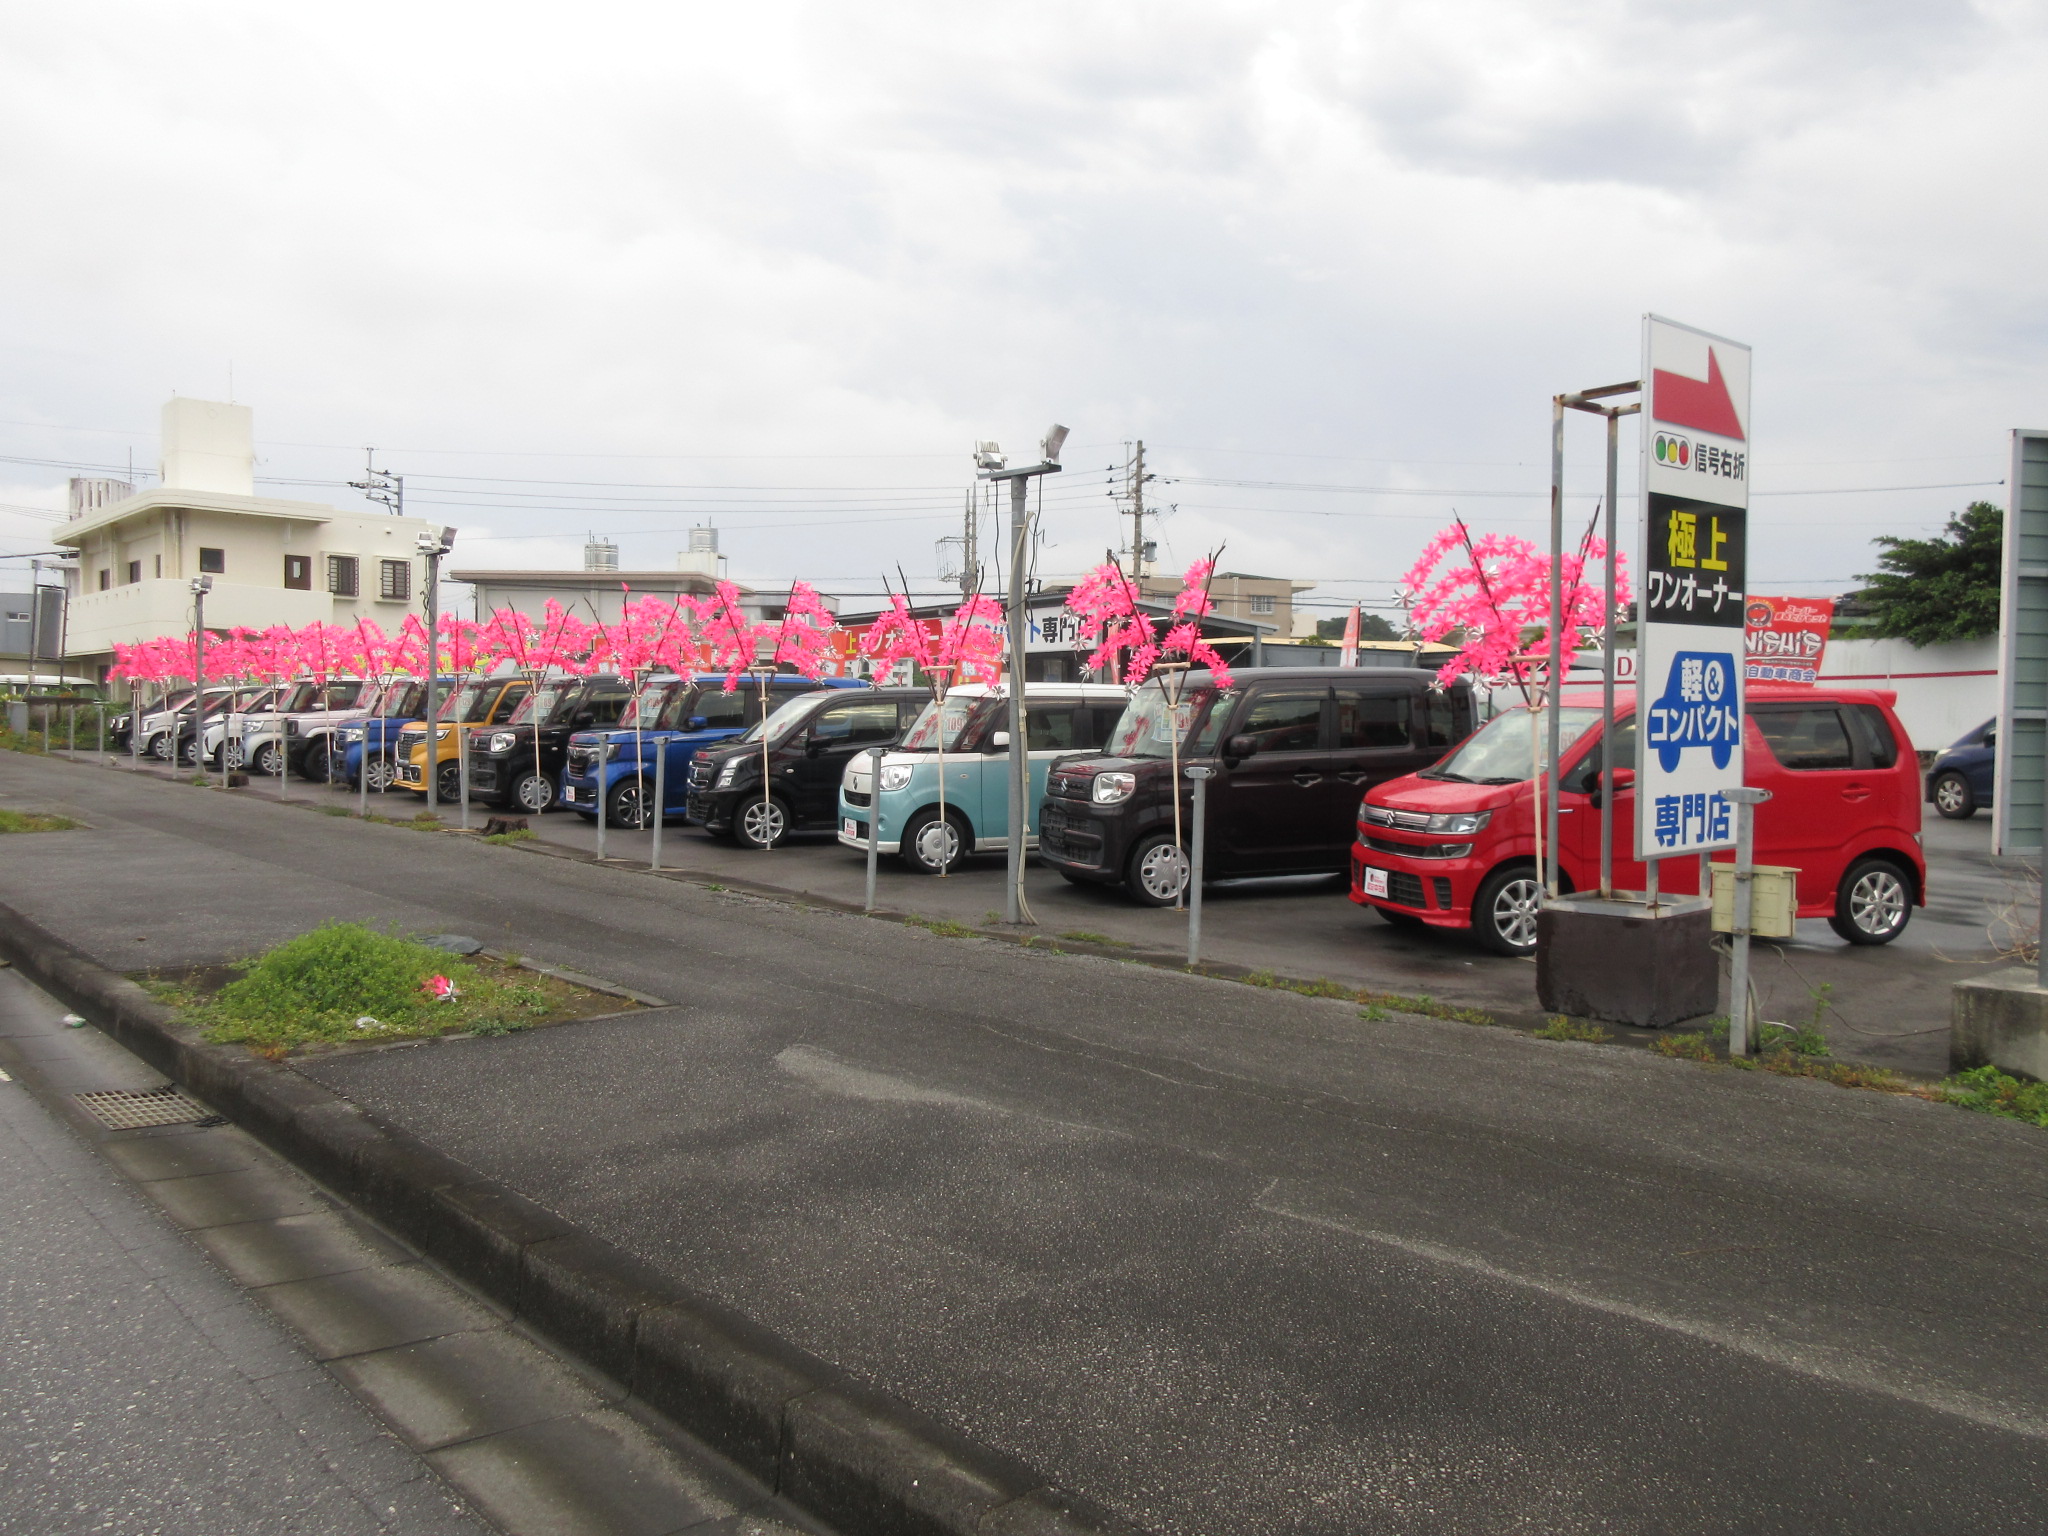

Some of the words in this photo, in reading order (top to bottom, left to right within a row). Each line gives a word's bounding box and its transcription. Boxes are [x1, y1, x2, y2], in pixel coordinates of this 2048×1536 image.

[1695, 443, 1745, 481] 信号右折
[1668, 510, 1727, 571] 極上
[1648, 571, 1743, 613] ワンオーナー
[1681, 658, 1723, 702] 軽&
[1745, 665, 1816, 683] 自動車商会
[1651, 705, 1738, 742] コンパクト
[1655, 790, 1731, 847] 専門店
